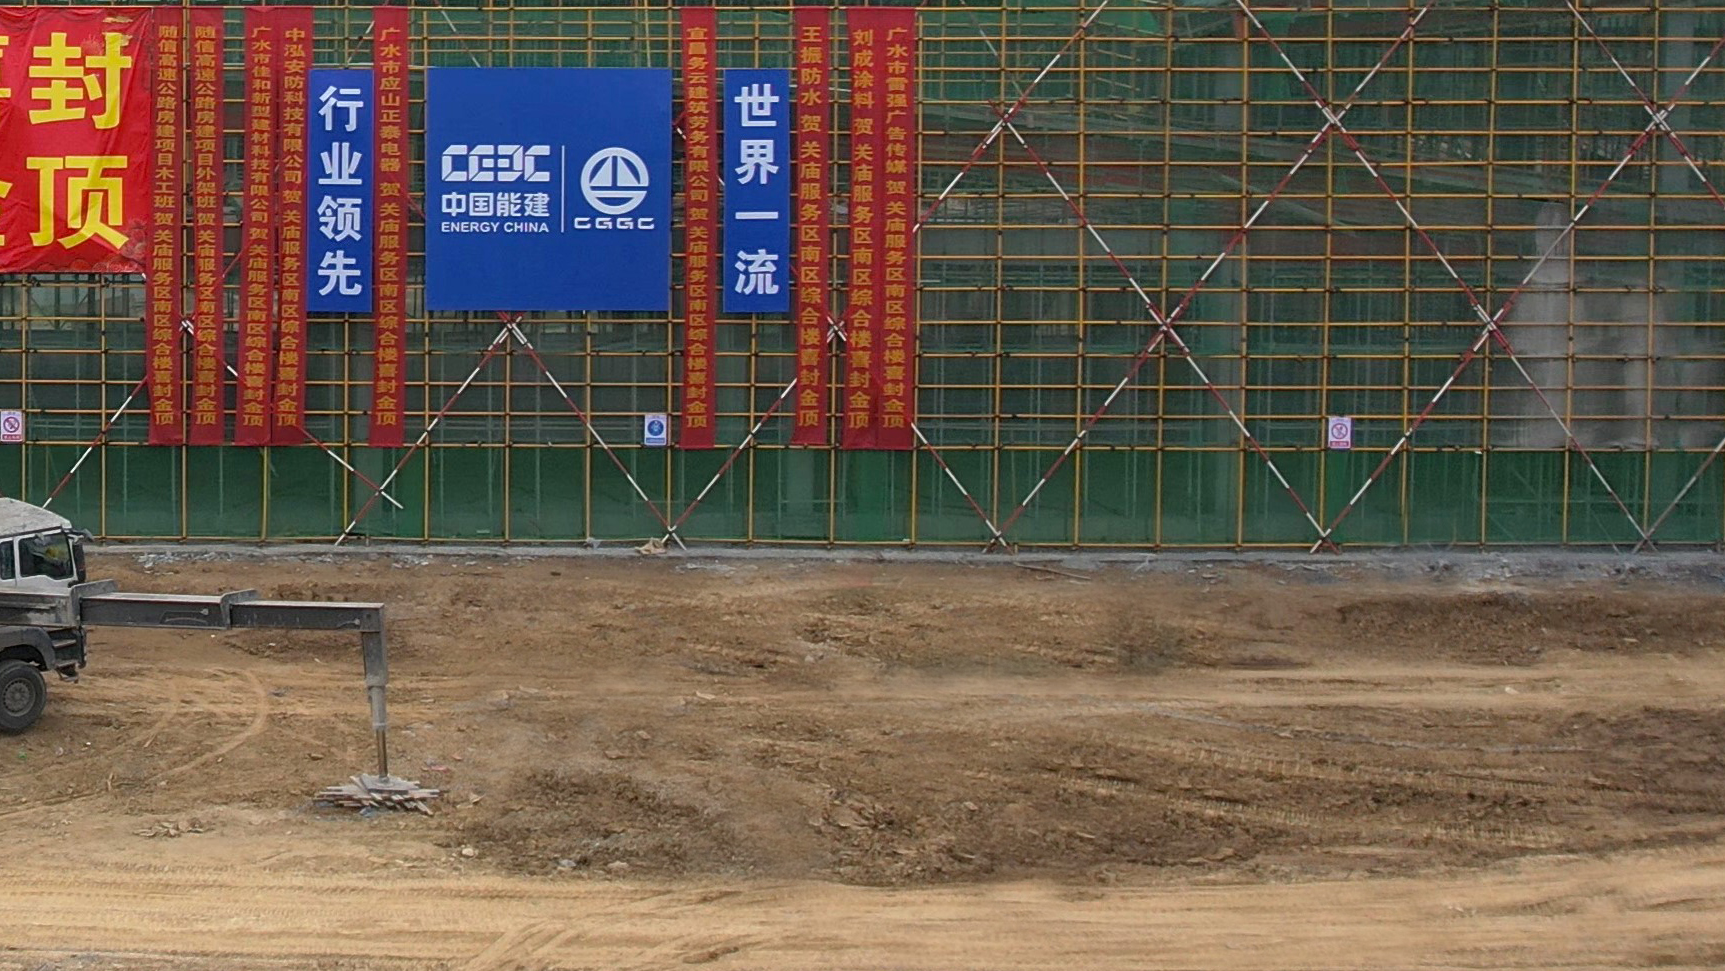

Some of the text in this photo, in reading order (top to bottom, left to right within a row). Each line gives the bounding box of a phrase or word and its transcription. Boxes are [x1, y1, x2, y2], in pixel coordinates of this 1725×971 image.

[799, 25, 824, 106] 王振防水
[852, 29, 876, 108] 刘成涂料
[153, 24, 178, 209] 随信高速公路房建项目木工班
[193, 24, 217, 210] 随信高速公路房建项目外架班
[799, 113, 823, 133] 贺
[852, 117, 874, 135] 贺
[317, 85, 364, 296] 行业领先
[378, 181, 401, 197] 贺
[734, 83, 780, 295] 世界一流
[885, 179, 908, 195] 贺
[281, 189, 303, 204] 贺
[441, 191, 550, 217] 中国能建
[154, 211, 175, 226] 贺
[194, 213, 217, 227] 贺
[688, 207, 710, 221] 贺
[441, 221, 549, 233] ENERGY CHINA
[574, 217, 655, 230] CGGC
[249, 225, 269, 240] 贺
